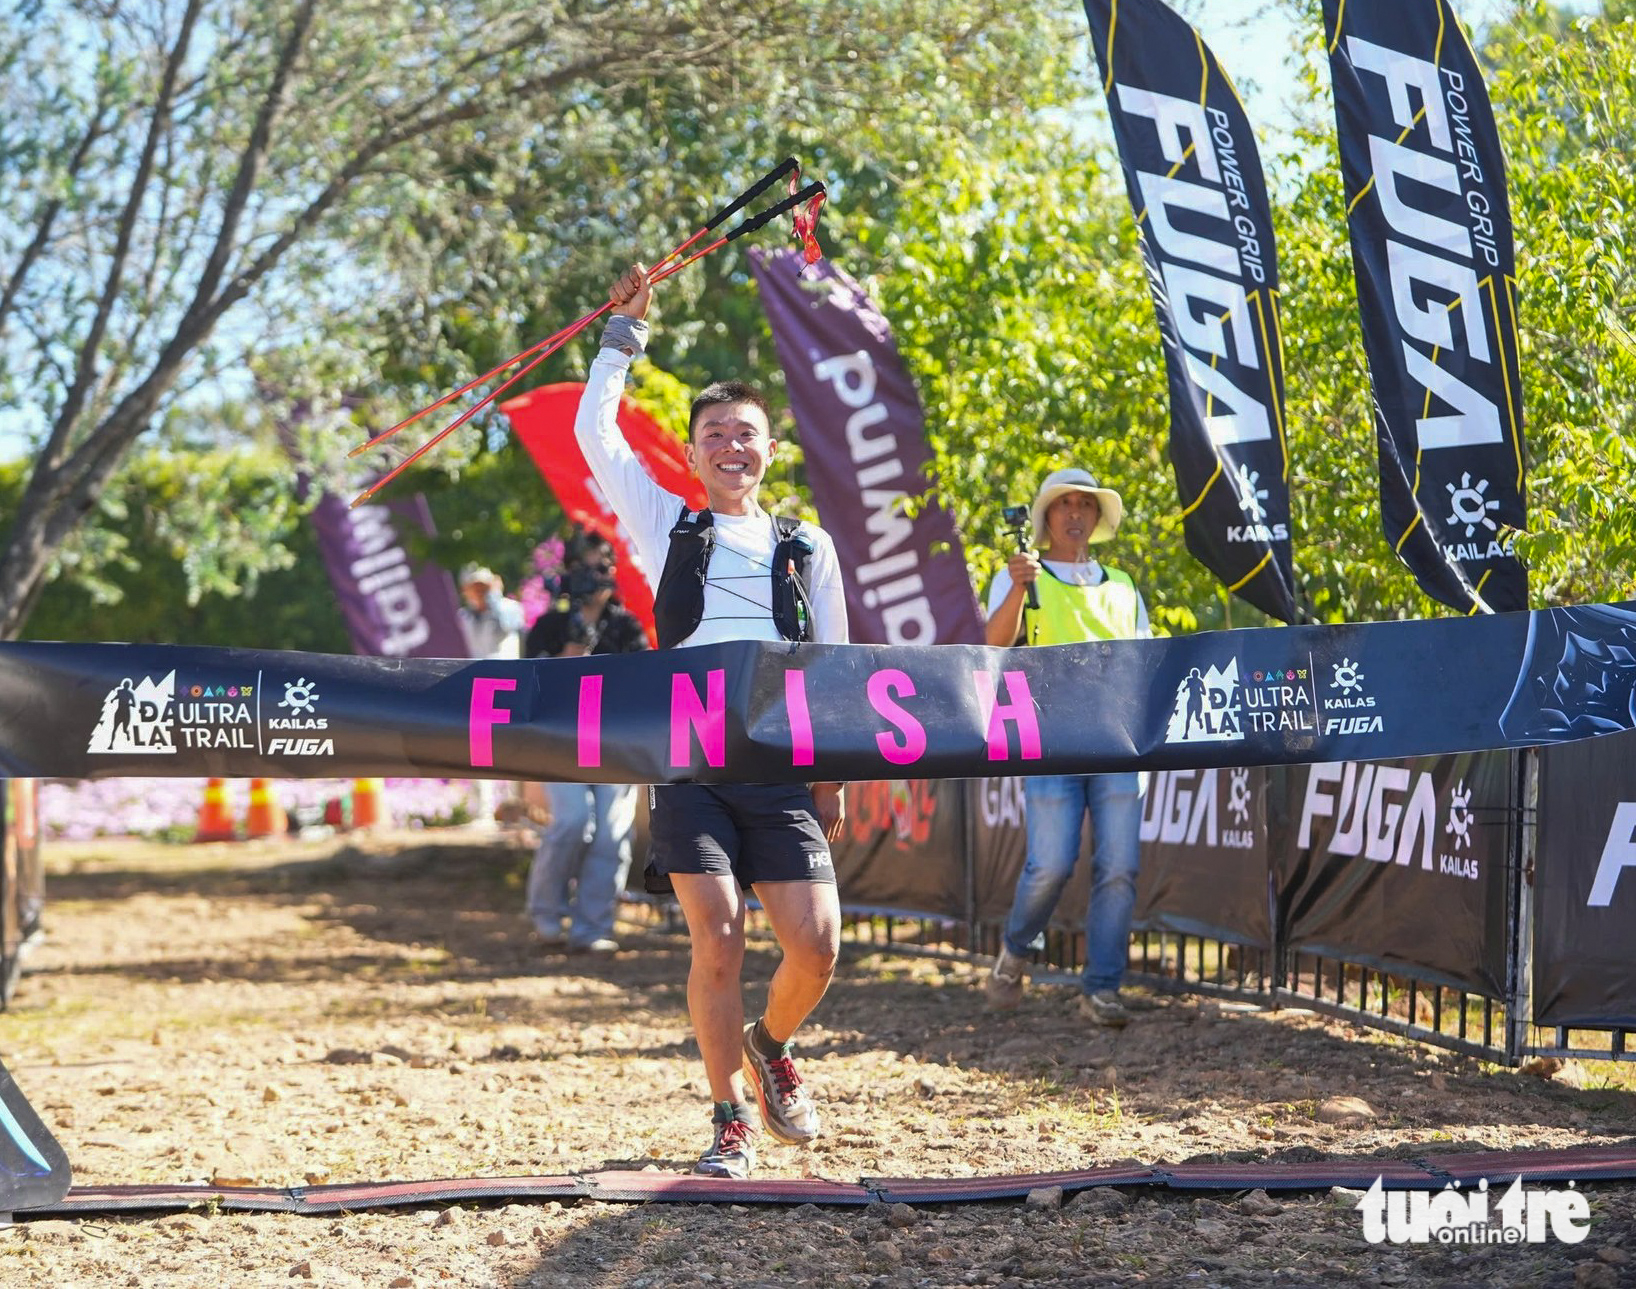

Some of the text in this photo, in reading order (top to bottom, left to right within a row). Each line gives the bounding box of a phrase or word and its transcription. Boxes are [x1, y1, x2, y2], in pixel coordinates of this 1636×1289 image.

[1440, 66, 1500, 268] POWER GRIP
[1206, 105, 1266, 284] POWER GRIP
[1346, 35, 1504, 450] FUGA
[1115, 83, 1272, 446] FUGA
[814, 350, 936, 646] ailwind
[1244, 685, 1310, 709] ULTRA
[1324, 697, 1377, 710] KAILAS
[178, 702, 252, 725] ULTRA
[268, 718, 328, 730] KAILAS
[469, 668, 1043, 768] FINISH
[1248, 710, 1313, 733] TRAIL
[1325, 716, 1384, 736] FUGA
[179, 728, 254, 749] TRAIL
[267, 738, 335, 756] FUGA
[1139, 768, 1218, 847] UGA
[1297, 760, 1436, 871] FUGA
[1222, 829, 1254, 850] KAILAS
[1439, 853, 1479, 881] KAILAS
